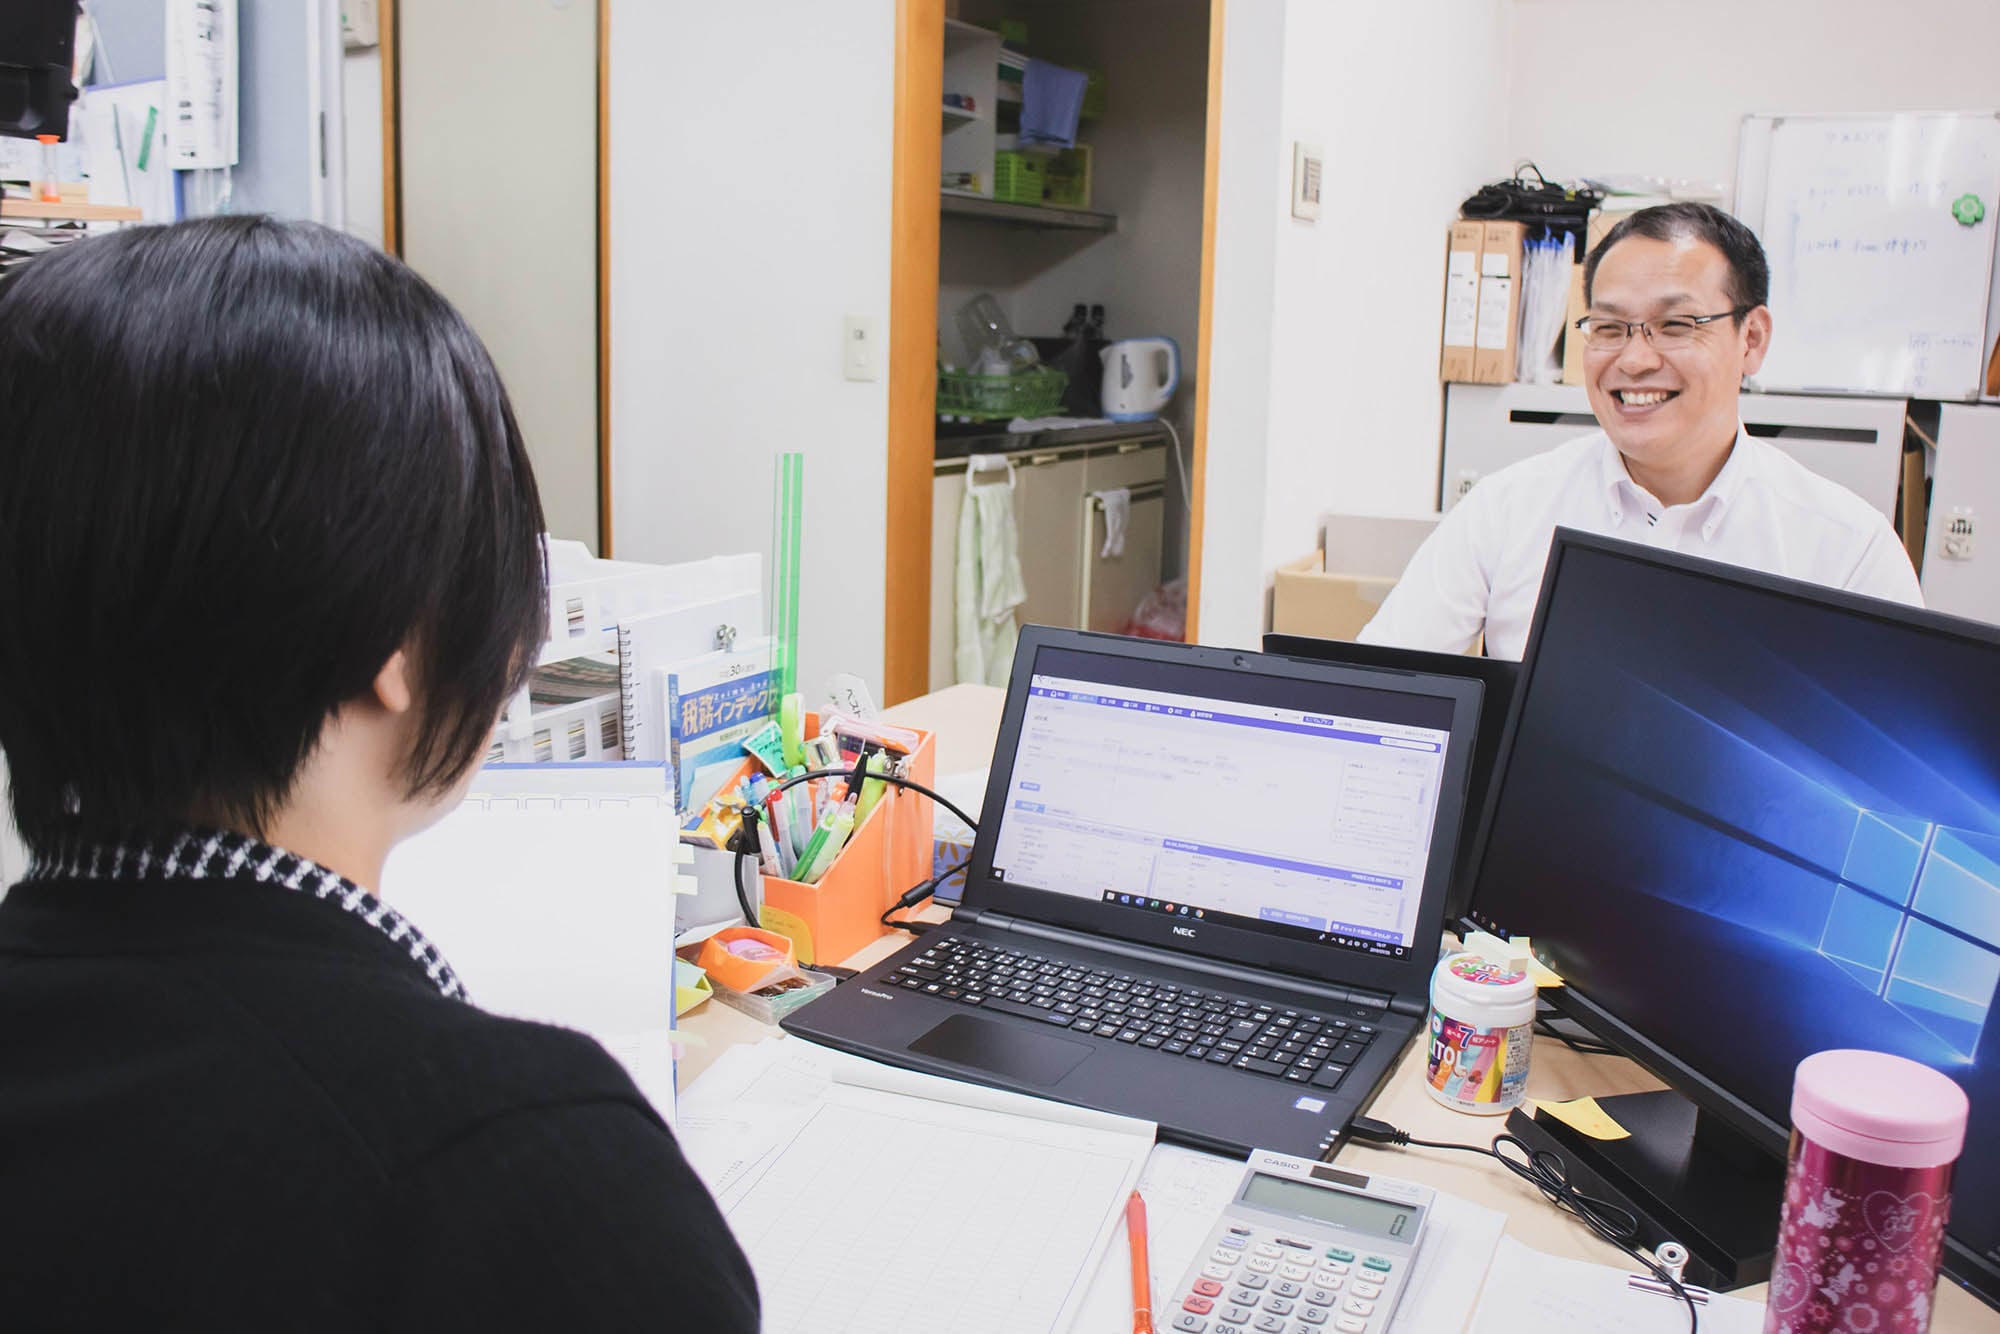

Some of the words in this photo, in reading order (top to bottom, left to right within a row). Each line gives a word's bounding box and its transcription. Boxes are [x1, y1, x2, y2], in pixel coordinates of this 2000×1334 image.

[1172, 926, 1196, 938] NEC
[1459, 1026, 1474, 1049] 7
[1263, 1157, 1300, 1170] CASIO
[1389, 1214, 1408, 1236] 0
[1248, 1273, 1259, 1283] 7
[1201, 1282, 1214, 1291] C
[1280, 1282, 1292, 1293] 8
[1238, 1291, 1249, 1300] 4
[1314, 1291, 1326, 1301] 9
[1187, 1298, 1209, 1308] AC
[1272, 1299, 1283, 1309] 5
[1231, 1308, 1239, 1317] 1
[1306, 1308, 1318, 1318] 6
[1183, 1316, 1195, 1326] 0
[1263, 1316, 1275, 1327] 2
[1215, 1324, 1236, 1334] 00
